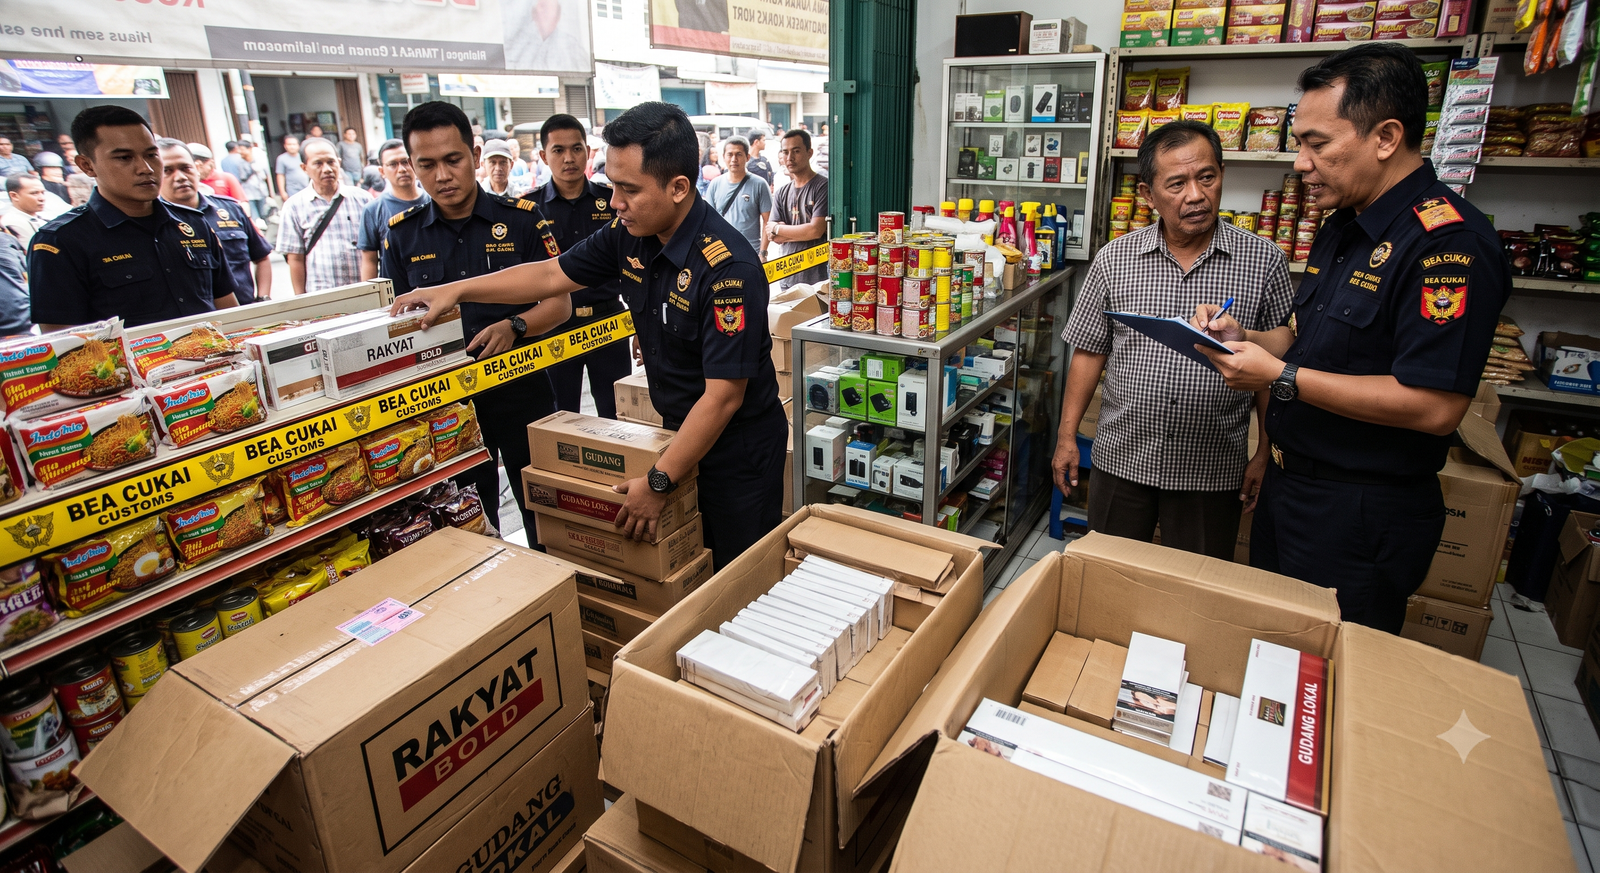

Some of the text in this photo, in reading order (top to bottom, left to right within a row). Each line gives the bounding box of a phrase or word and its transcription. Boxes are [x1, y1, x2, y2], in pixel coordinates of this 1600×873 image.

[1423, 253, 1471, 268] BEA CUKAI
[1424, 276, 1466, 284] BEA CUKAI
[569, 319, 619, 346] BEA CUKAI
[581, 333, 613, 350] CUSTOMS
[367, 336, 415, 363] RAKYAT
[421, 347, 443, 361] BOLD
[483, 345, 543, 377] BEA CUKAI
[498, 362, 535, 380] CUSTOMS
[378, 377, 451, 414] BEA CUKAI
[396, 396, 441, 418] CUSTOMS
[245, 416, 338, 461] BEA CUKAI
[267, 437, 326, 466] CUSTOMS
[585, 451, 621, 467] GUDANG
[66, 493, 119, 523] BEA
[121, 466, 192, 504] CUKAI
[97, 491, 176, 527] CUSTOMS
[561, 493, 590, 507] GUDANG
[391, 646, 539, 783] RAKYAT
[1297, 682, 1318, 765] GUDANG LOKAL
[434, 703, 520, 782] BOLD
[455, 774, 562, 873] GUDANG
[486, 809, 562, 873] OKAL
